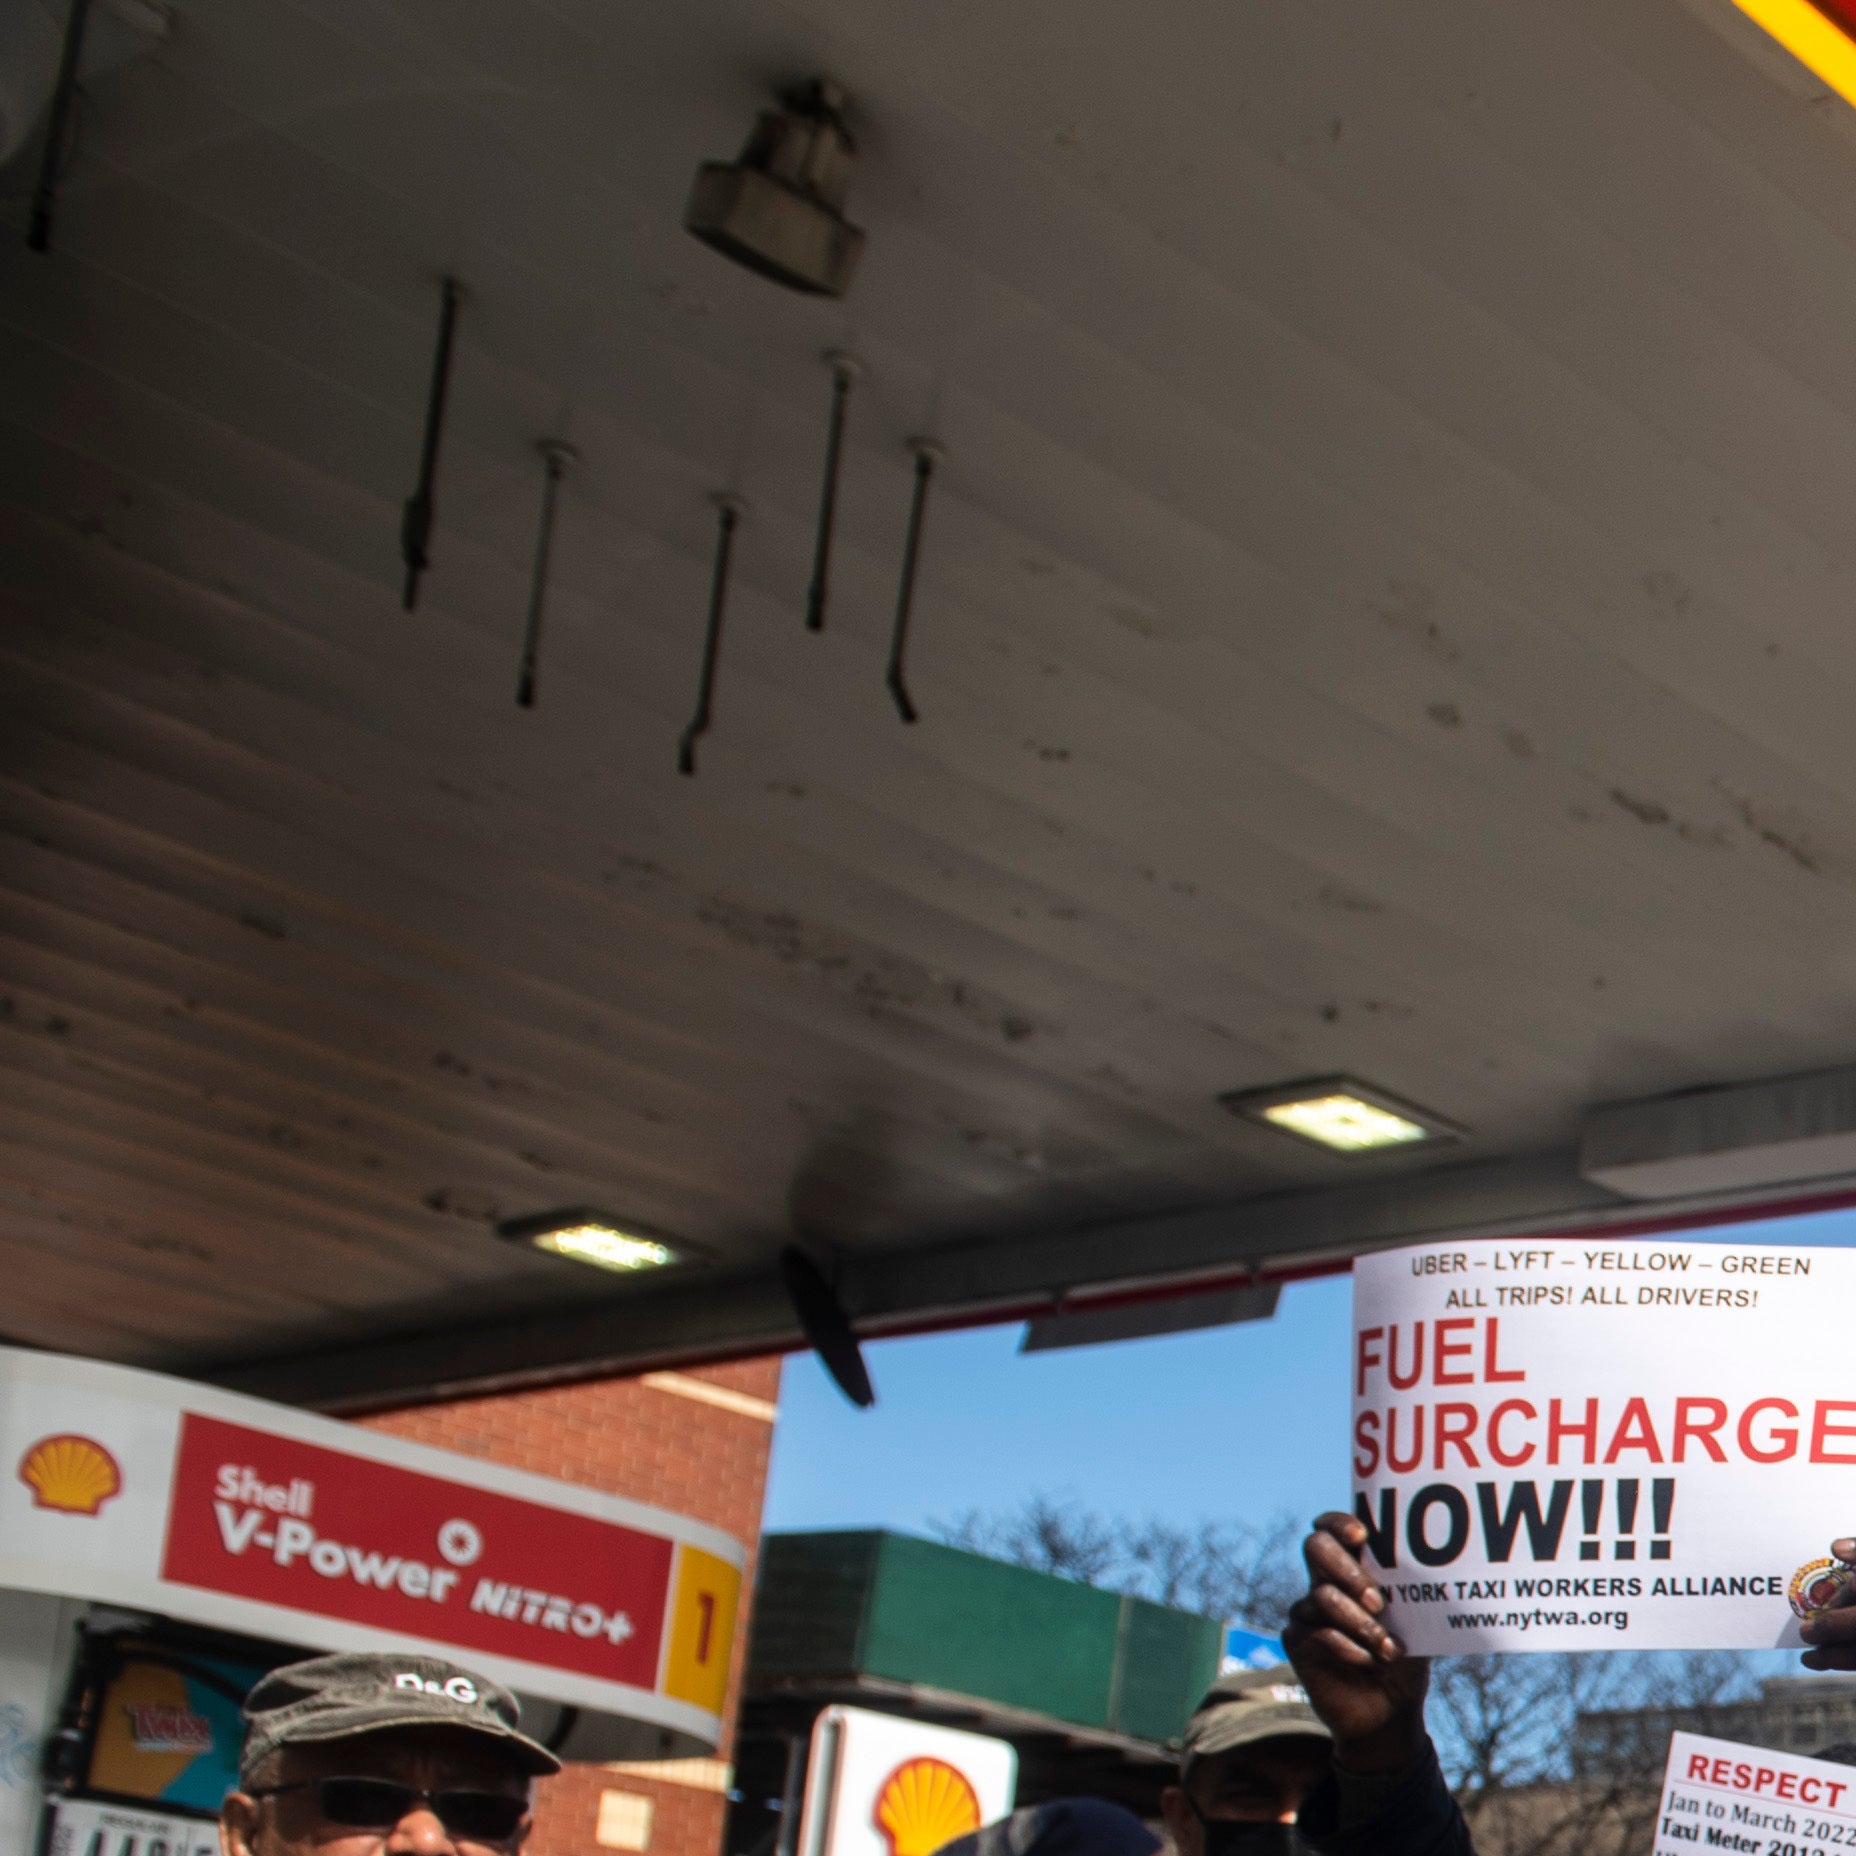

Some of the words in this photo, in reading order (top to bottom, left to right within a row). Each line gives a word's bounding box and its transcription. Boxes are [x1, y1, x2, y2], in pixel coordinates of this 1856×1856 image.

[1355, 1316, 1526, 1400] FUEL
[215, 1464, 313, 1518] Shell
[1355, 1478, 1677, 1570] NOW!!!
[213, 1500, 458, 1604] V-Power
[1400, 1581, 1450, 1605] YORK
[1454, 1580, 1506, 1601] TAXI
[1515, 1578, 1642, 1598] WORKERS
[1651, 1576, 1783, 1596] ALLIANCE
[696, 1592, 716, 1666] 1
[1447, 1606, 1628, 1631] www.nytwa.org
[1687, 1754, 1847, 1808] RESPECT
[1662, 1817, 1700, 1842] Taxi
[1707, 1827, 1762, 1854] Meter
[1668, 1791, 1699, 1813] Jan
[1706, 1801, 1725, 1818] to
[1734, 1804, 1796, 1834] March
